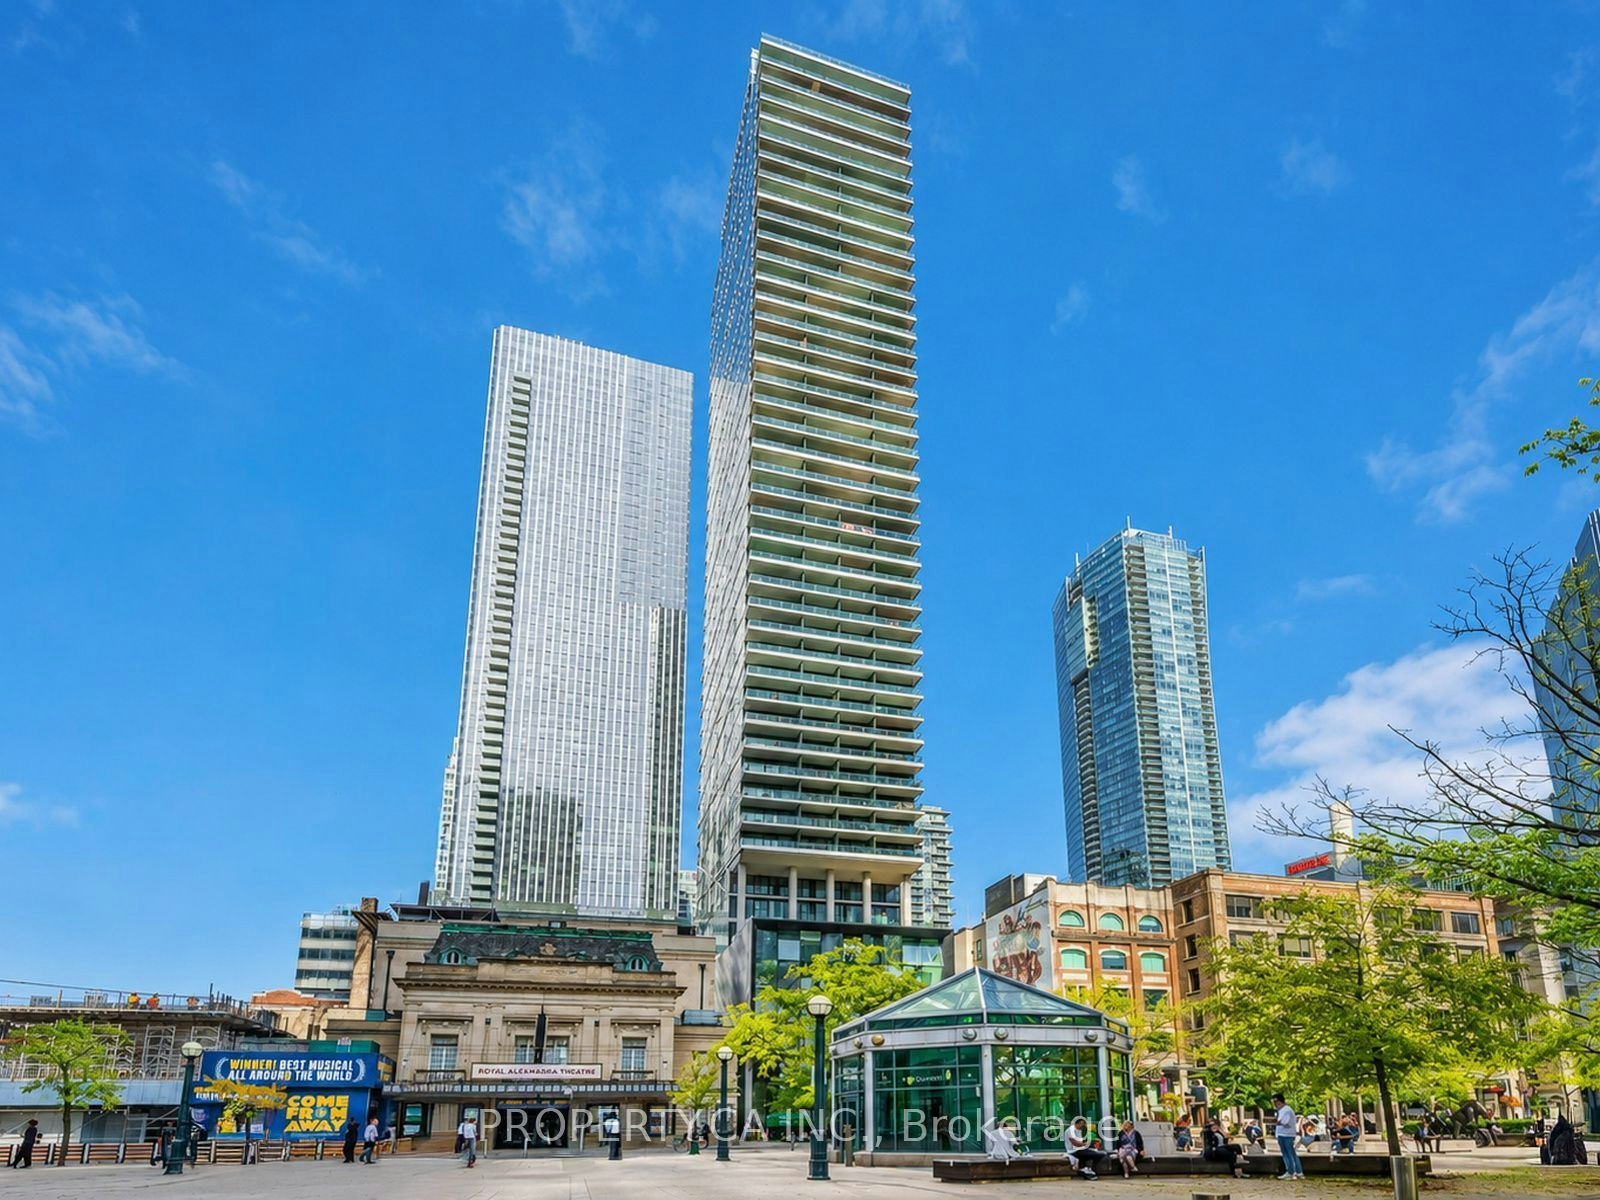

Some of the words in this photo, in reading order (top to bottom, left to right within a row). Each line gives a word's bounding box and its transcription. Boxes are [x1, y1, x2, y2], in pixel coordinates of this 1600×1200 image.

[279, 1059, 307, 1070] BEST
[308, 1059, 354, 1071] MUSICAL
[228, 1069, 247, 1081] ALL
[295, 1070, 313, 1081] THE
[287, 1095, 350, 1107] COME
[283, 1119, 347, 1133] AWAY
